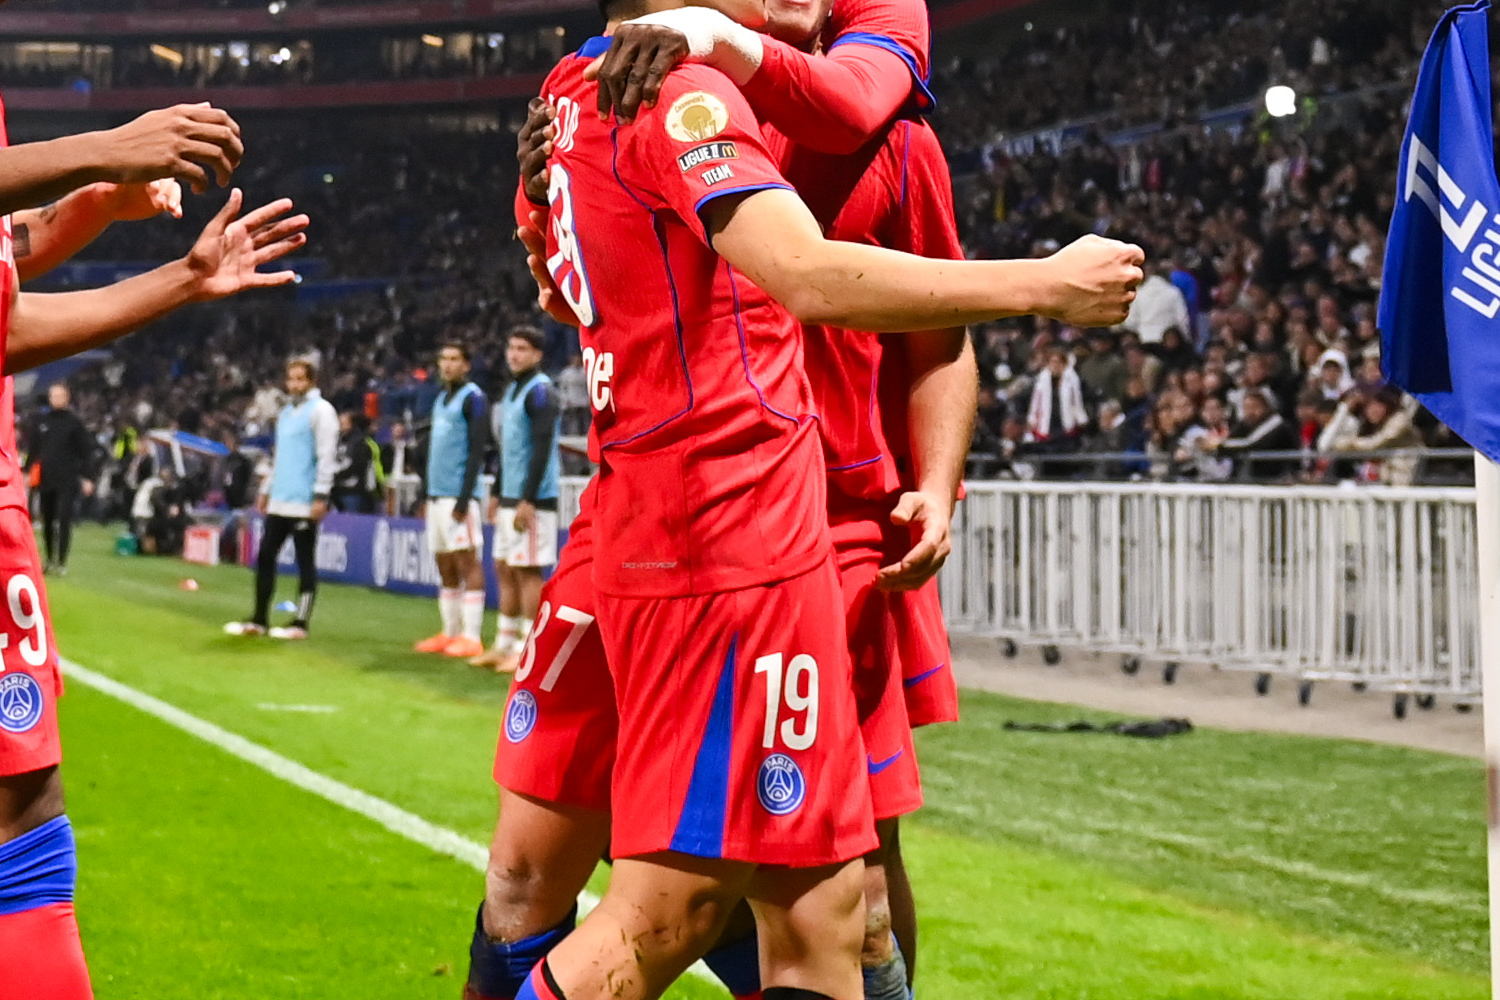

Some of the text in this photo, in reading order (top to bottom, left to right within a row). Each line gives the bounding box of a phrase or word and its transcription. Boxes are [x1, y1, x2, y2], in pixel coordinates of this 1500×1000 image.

[679, 146, 711, 171] LIGUE
[515, 600, 595, 692] 87
[754, 652, 819, 750] 19
[765, 757, 795, 774] PARIS
